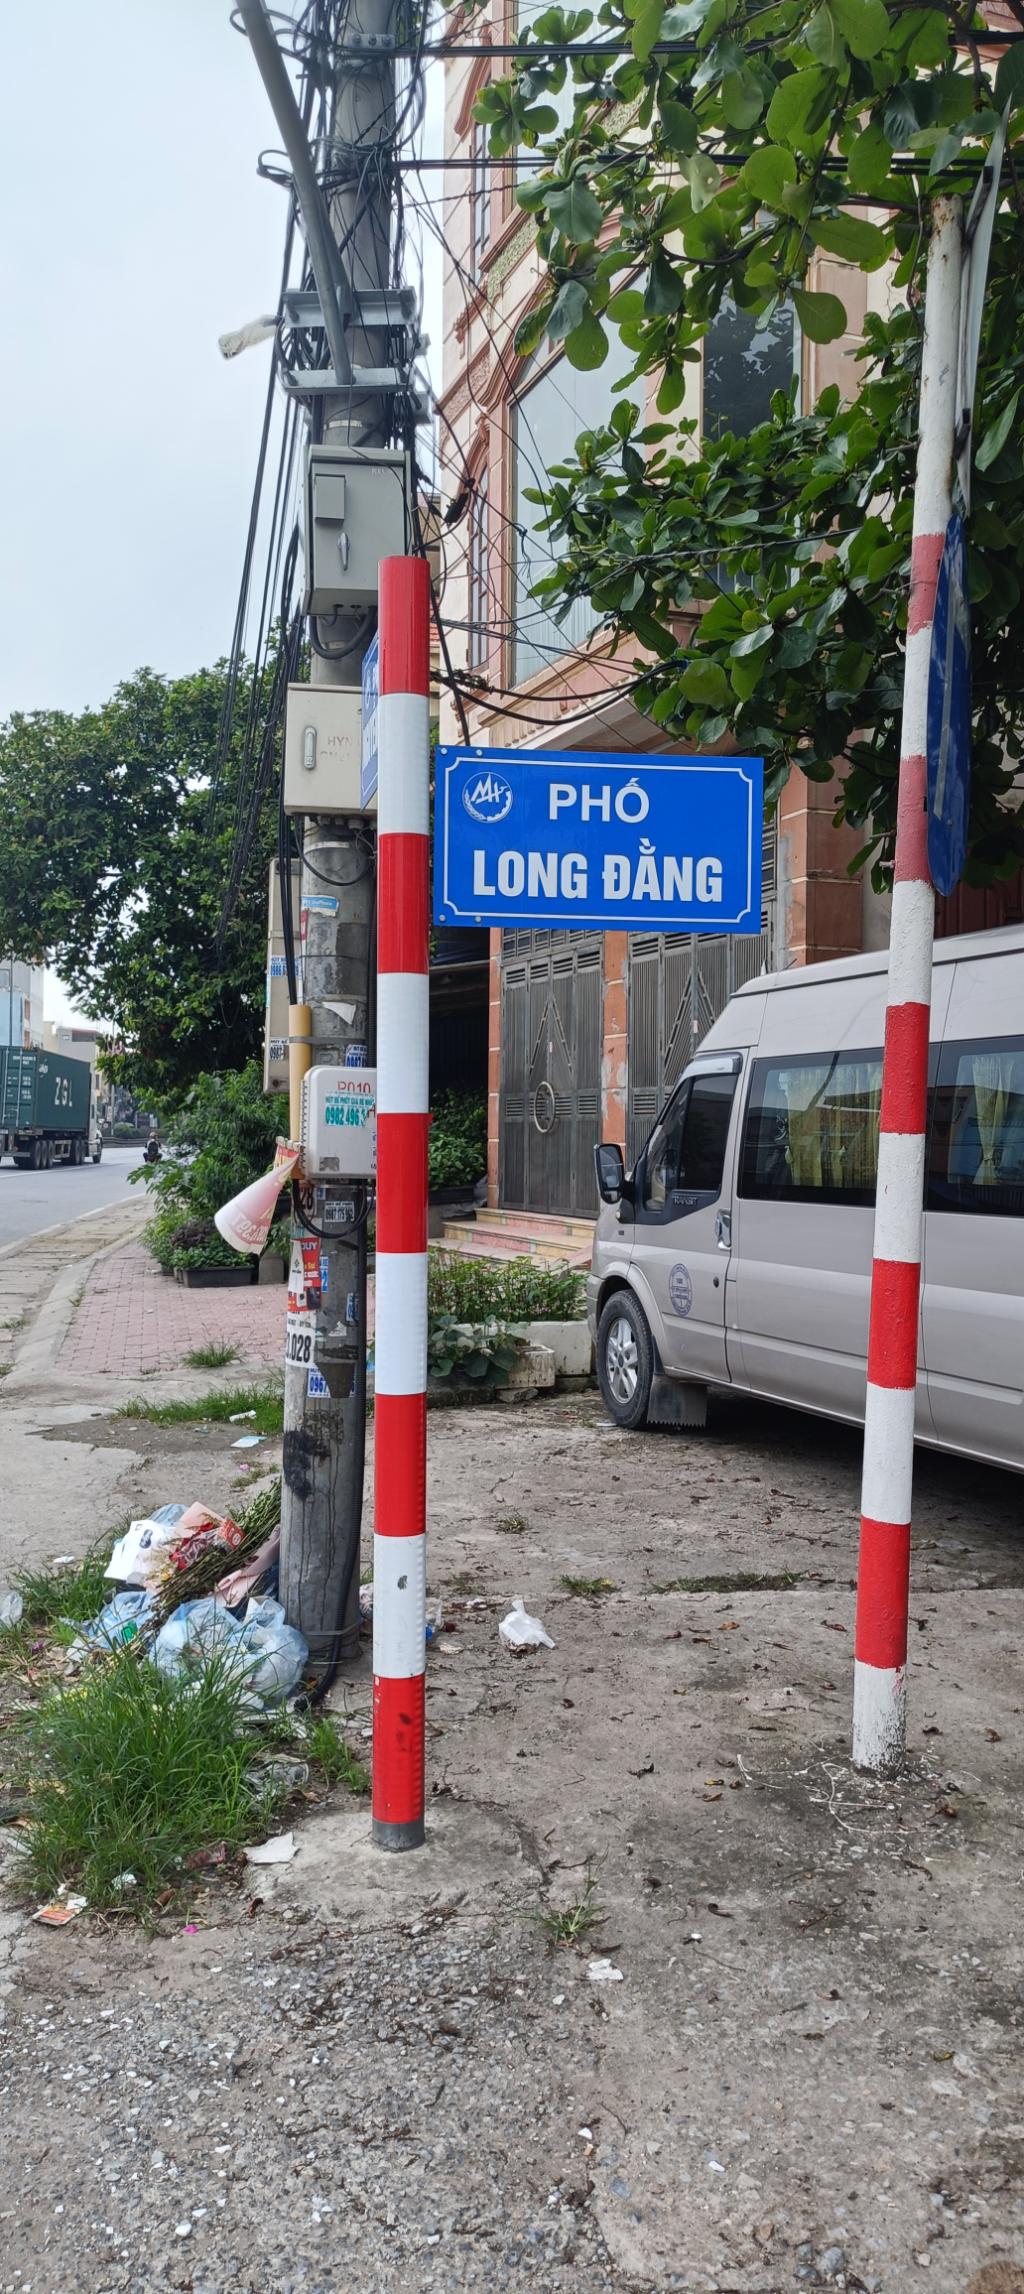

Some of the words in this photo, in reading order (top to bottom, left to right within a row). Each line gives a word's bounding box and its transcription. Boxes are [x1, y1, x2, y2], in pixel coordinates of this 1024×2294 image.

[550, 777, 650, 823] PHỐ
[473, 850, 588, 899] LONG
[602, 838, 723, 902] ĐẰNG
